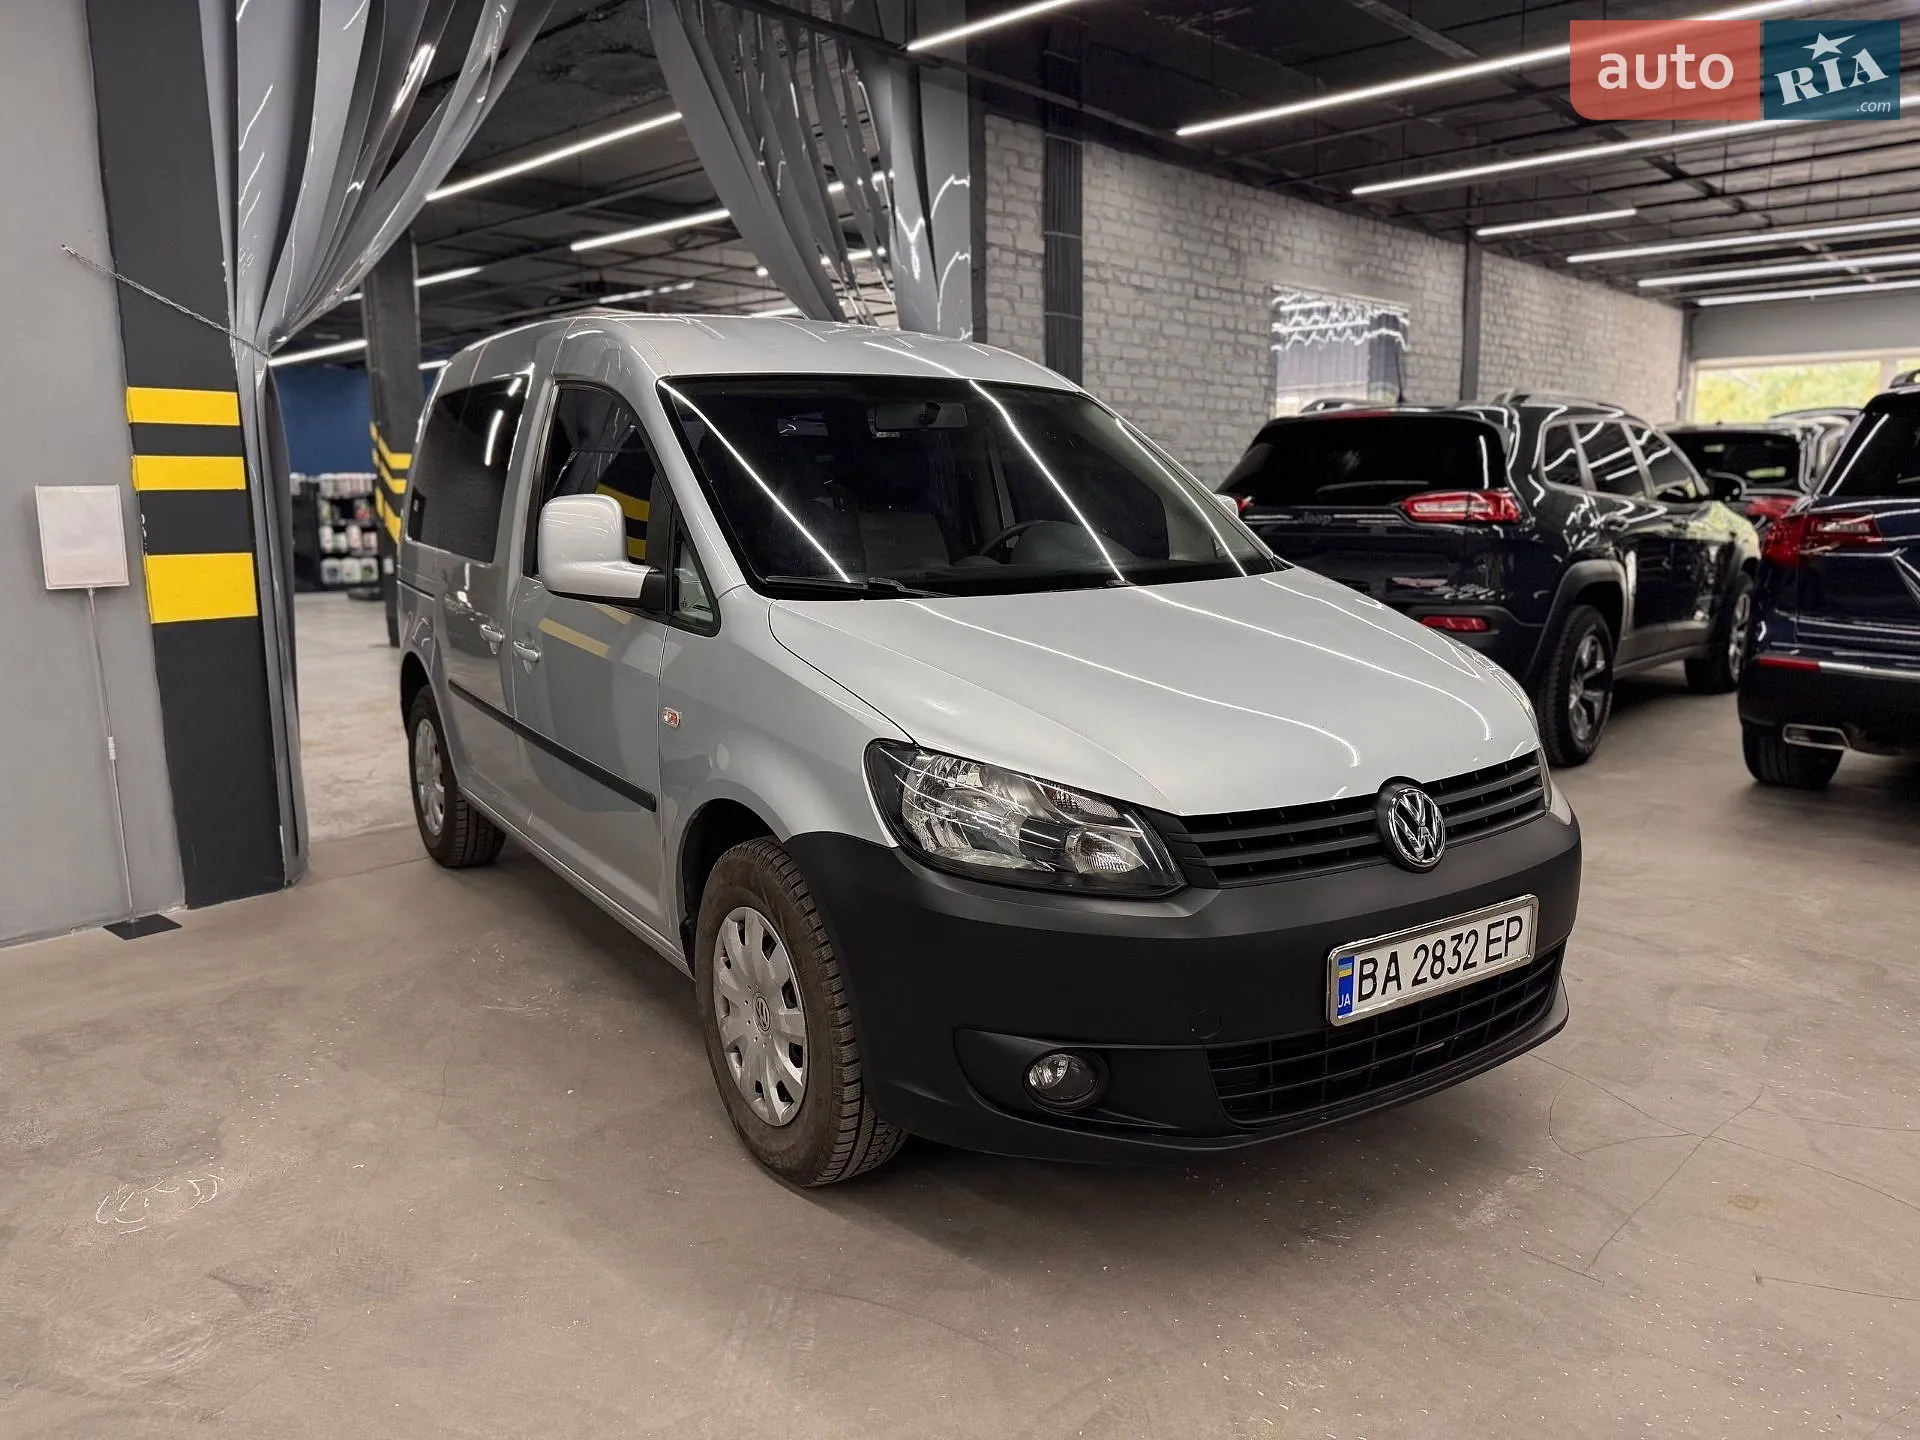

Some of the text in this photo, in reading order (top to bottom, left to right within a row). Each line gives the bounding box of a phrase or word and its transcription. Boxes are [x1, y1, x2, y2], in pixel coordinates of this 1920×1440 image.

[1357, 915, 1524, 1003] BA 2832 EP
[1337, 993, 1351, 1008] UA
